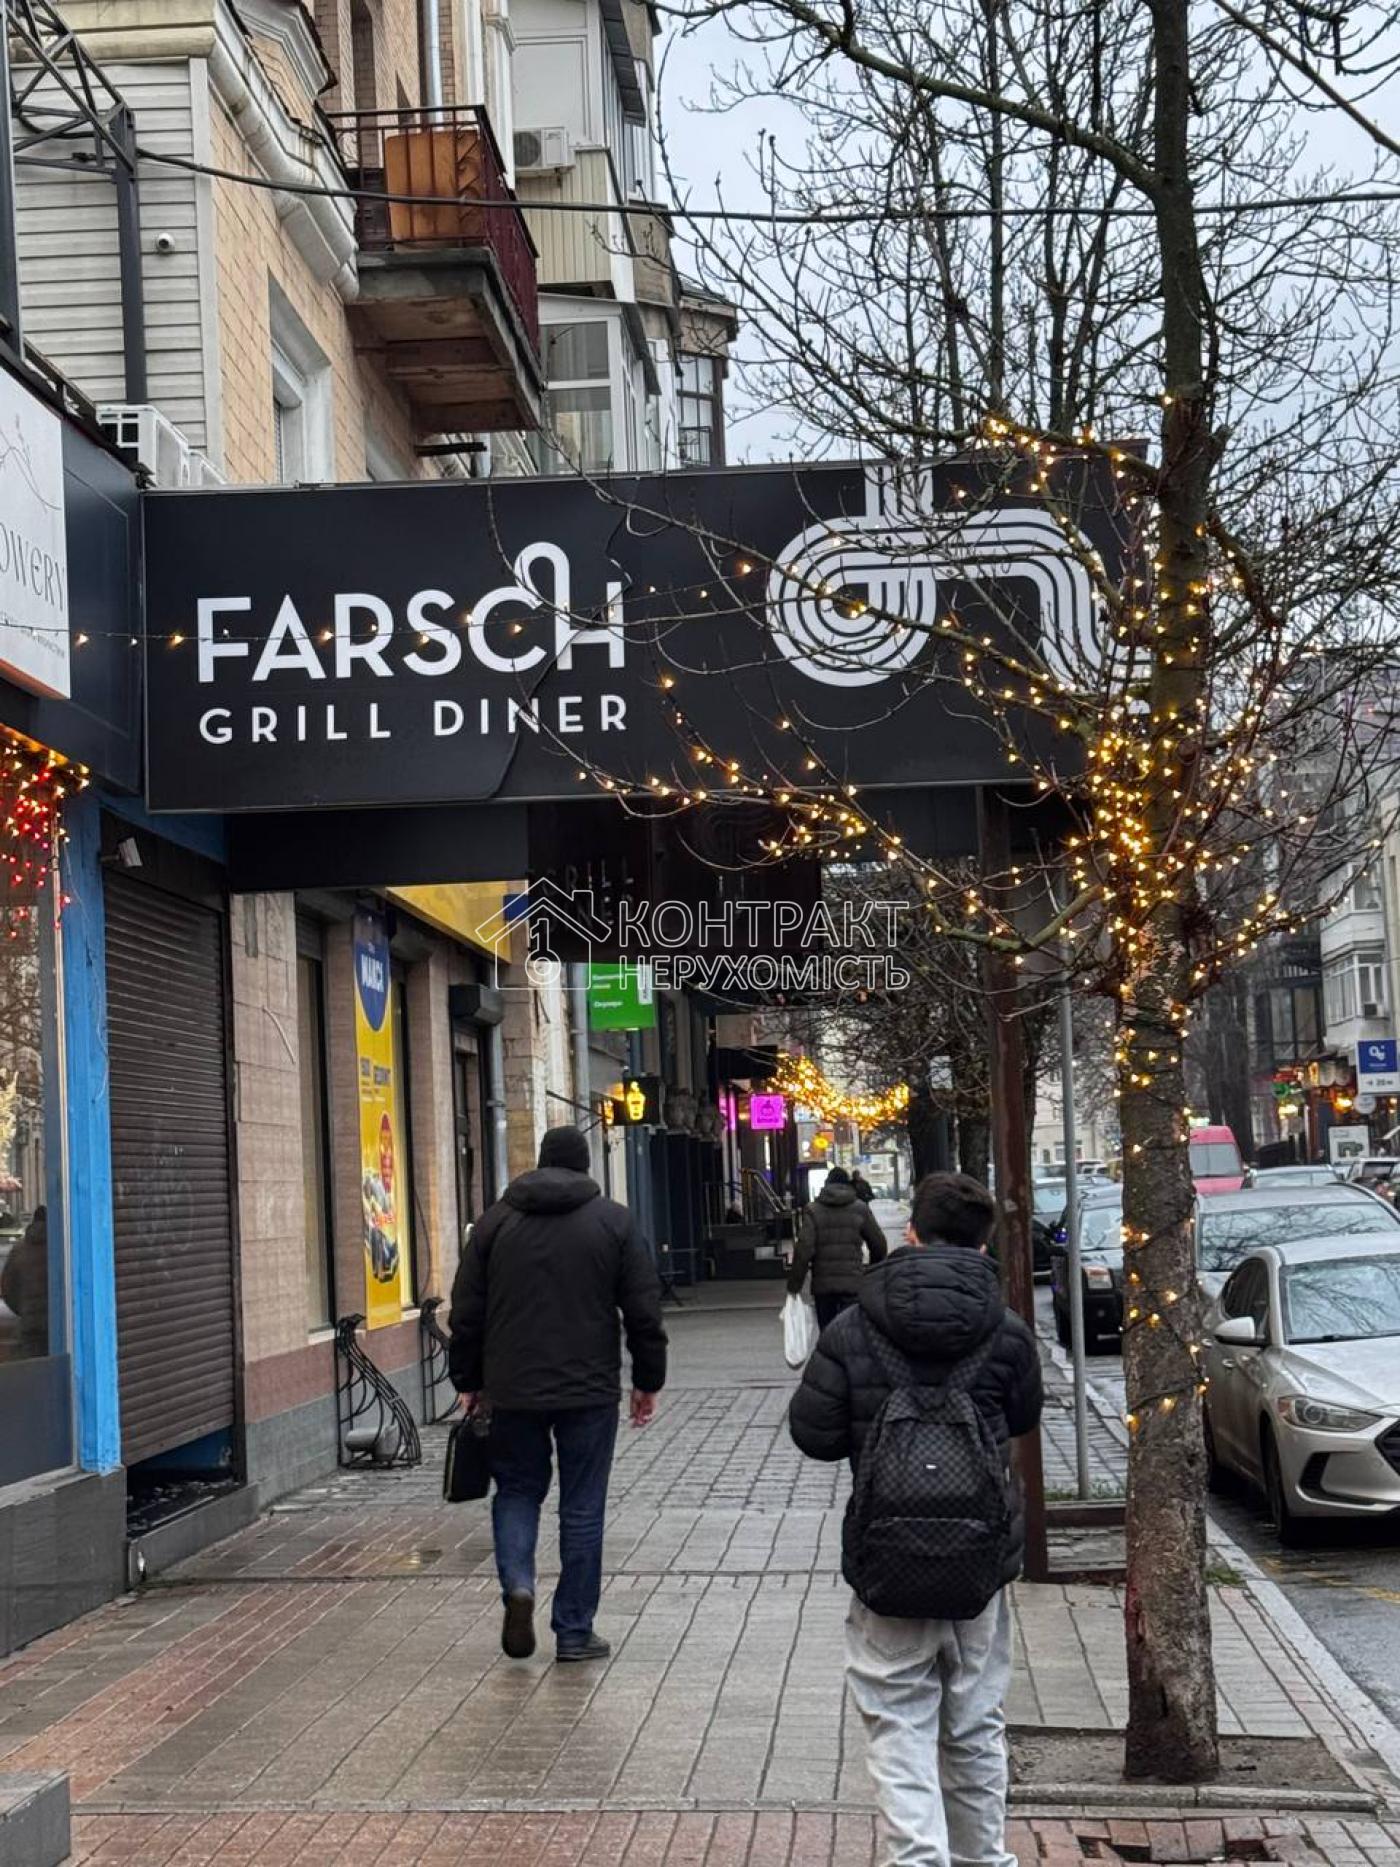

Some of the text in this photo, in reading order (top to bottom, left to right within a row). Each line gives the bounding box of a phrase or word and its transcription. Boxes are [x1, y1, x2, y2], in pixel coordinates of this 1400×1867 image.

[197, 541, 625, 683] FARSCH
[200, 694, 628, 745] GRILL DINER
